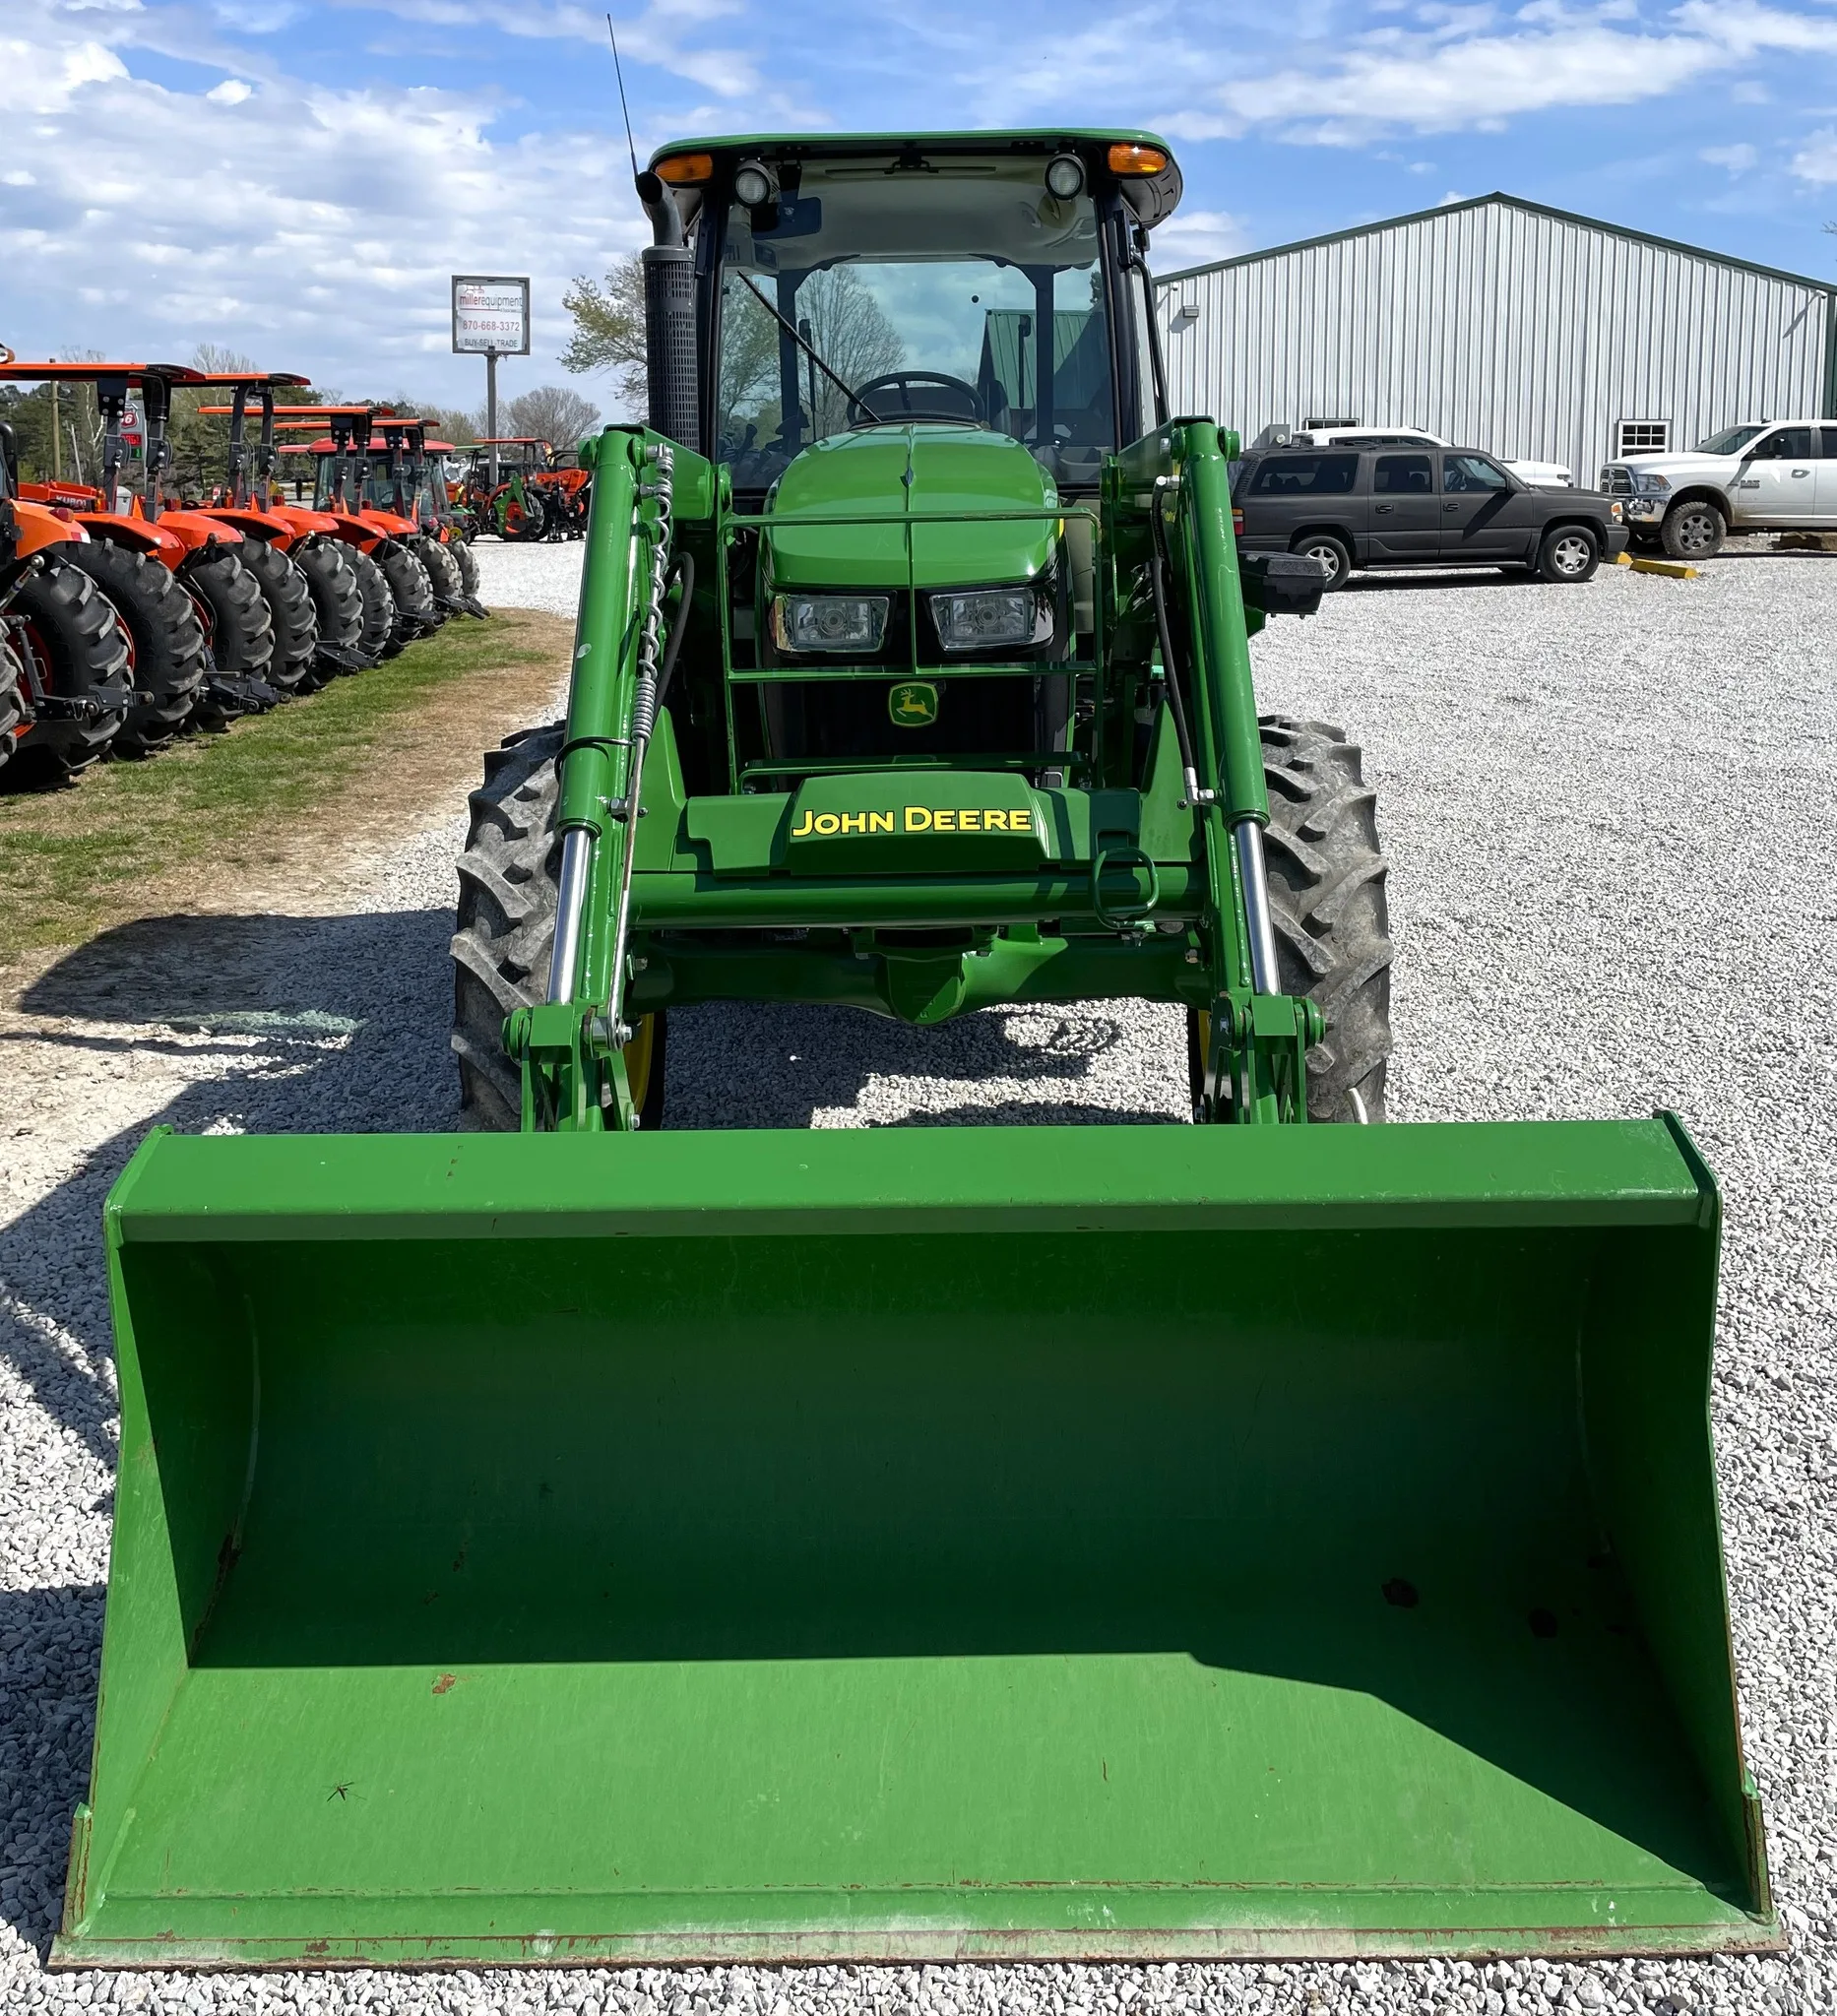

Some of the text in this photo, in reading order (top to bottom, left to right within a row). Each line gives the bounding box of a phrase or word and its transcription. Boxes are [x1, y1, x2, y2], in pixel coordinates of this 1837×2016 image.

[463, 320, 520, 332] 870-668-3372
[792, 806, 1032, 837] JOHN DEERE
